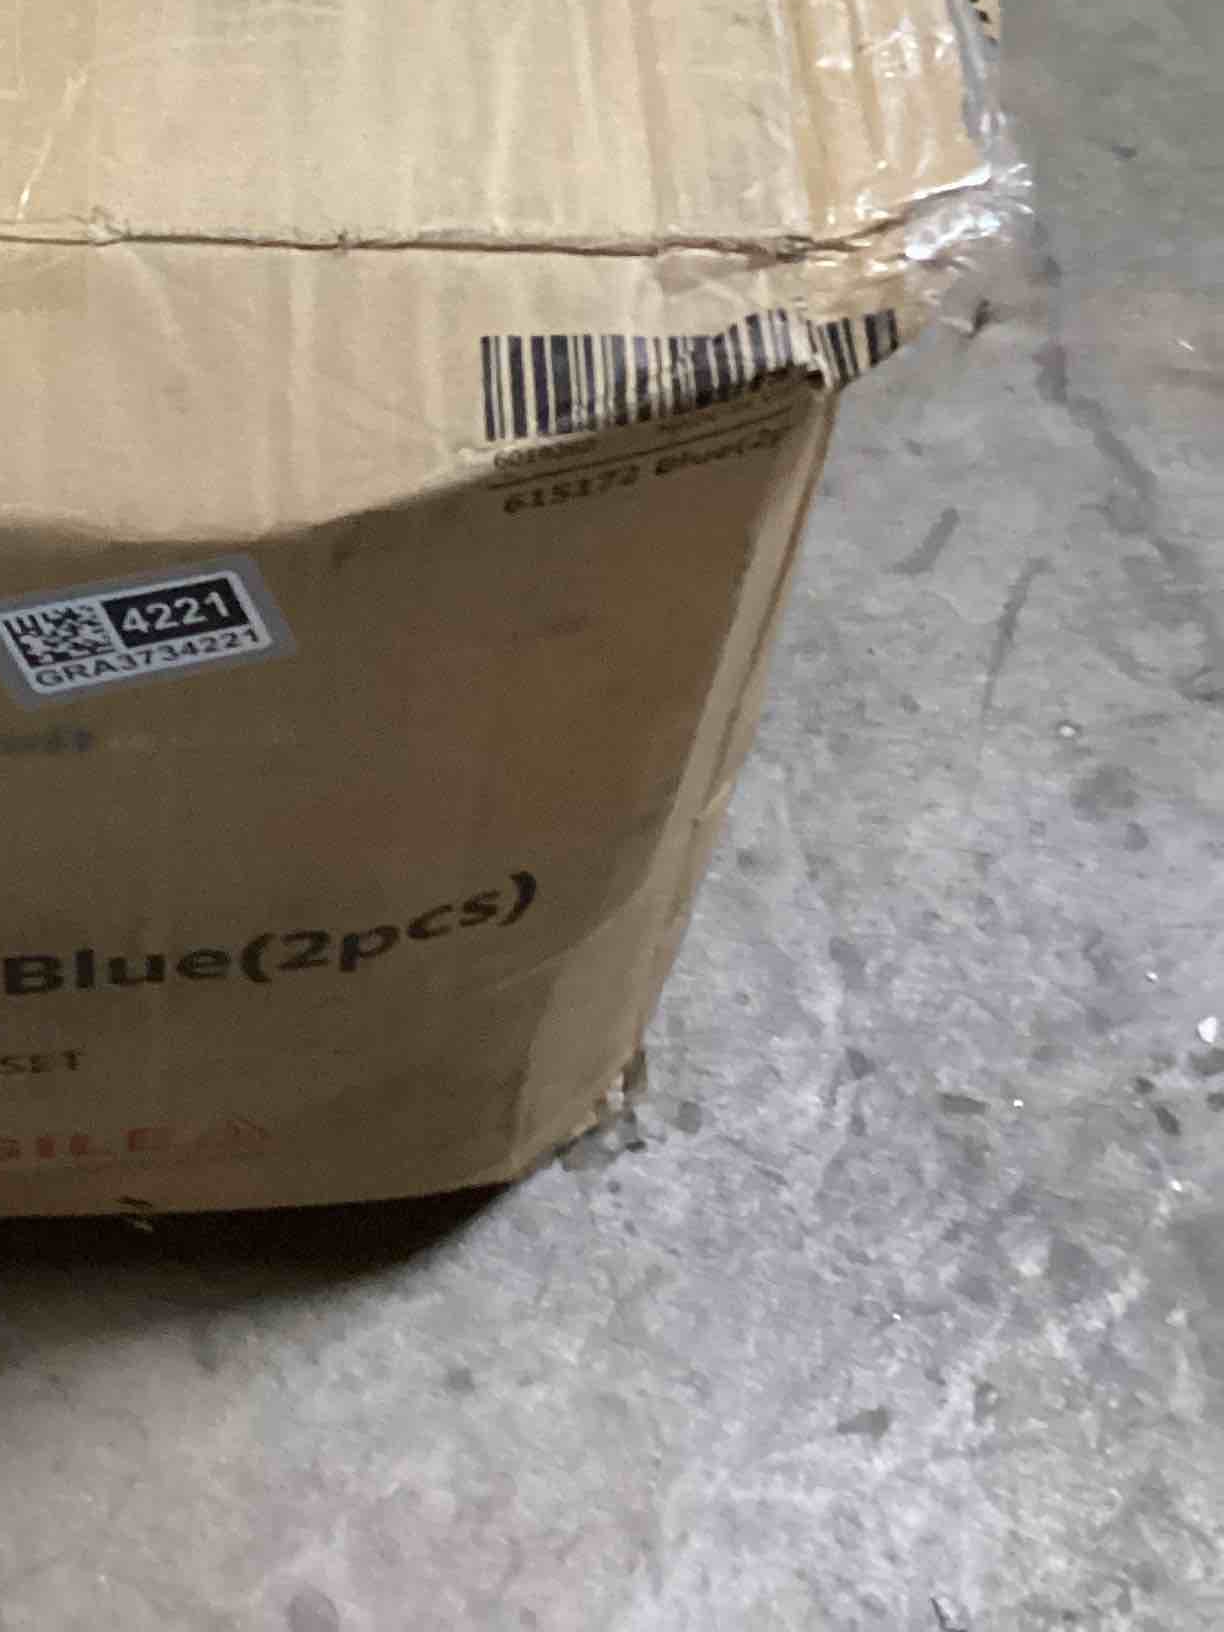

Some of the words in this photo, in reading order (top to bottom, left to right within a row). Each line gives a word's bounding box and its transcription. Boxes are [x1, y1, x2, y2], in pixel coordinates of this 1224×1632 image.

[122, 590, 230, 635] 4221
[35, 628, 262, 687] GRA3734221
[2, 870, 539, 997] Blue(2pcs)
